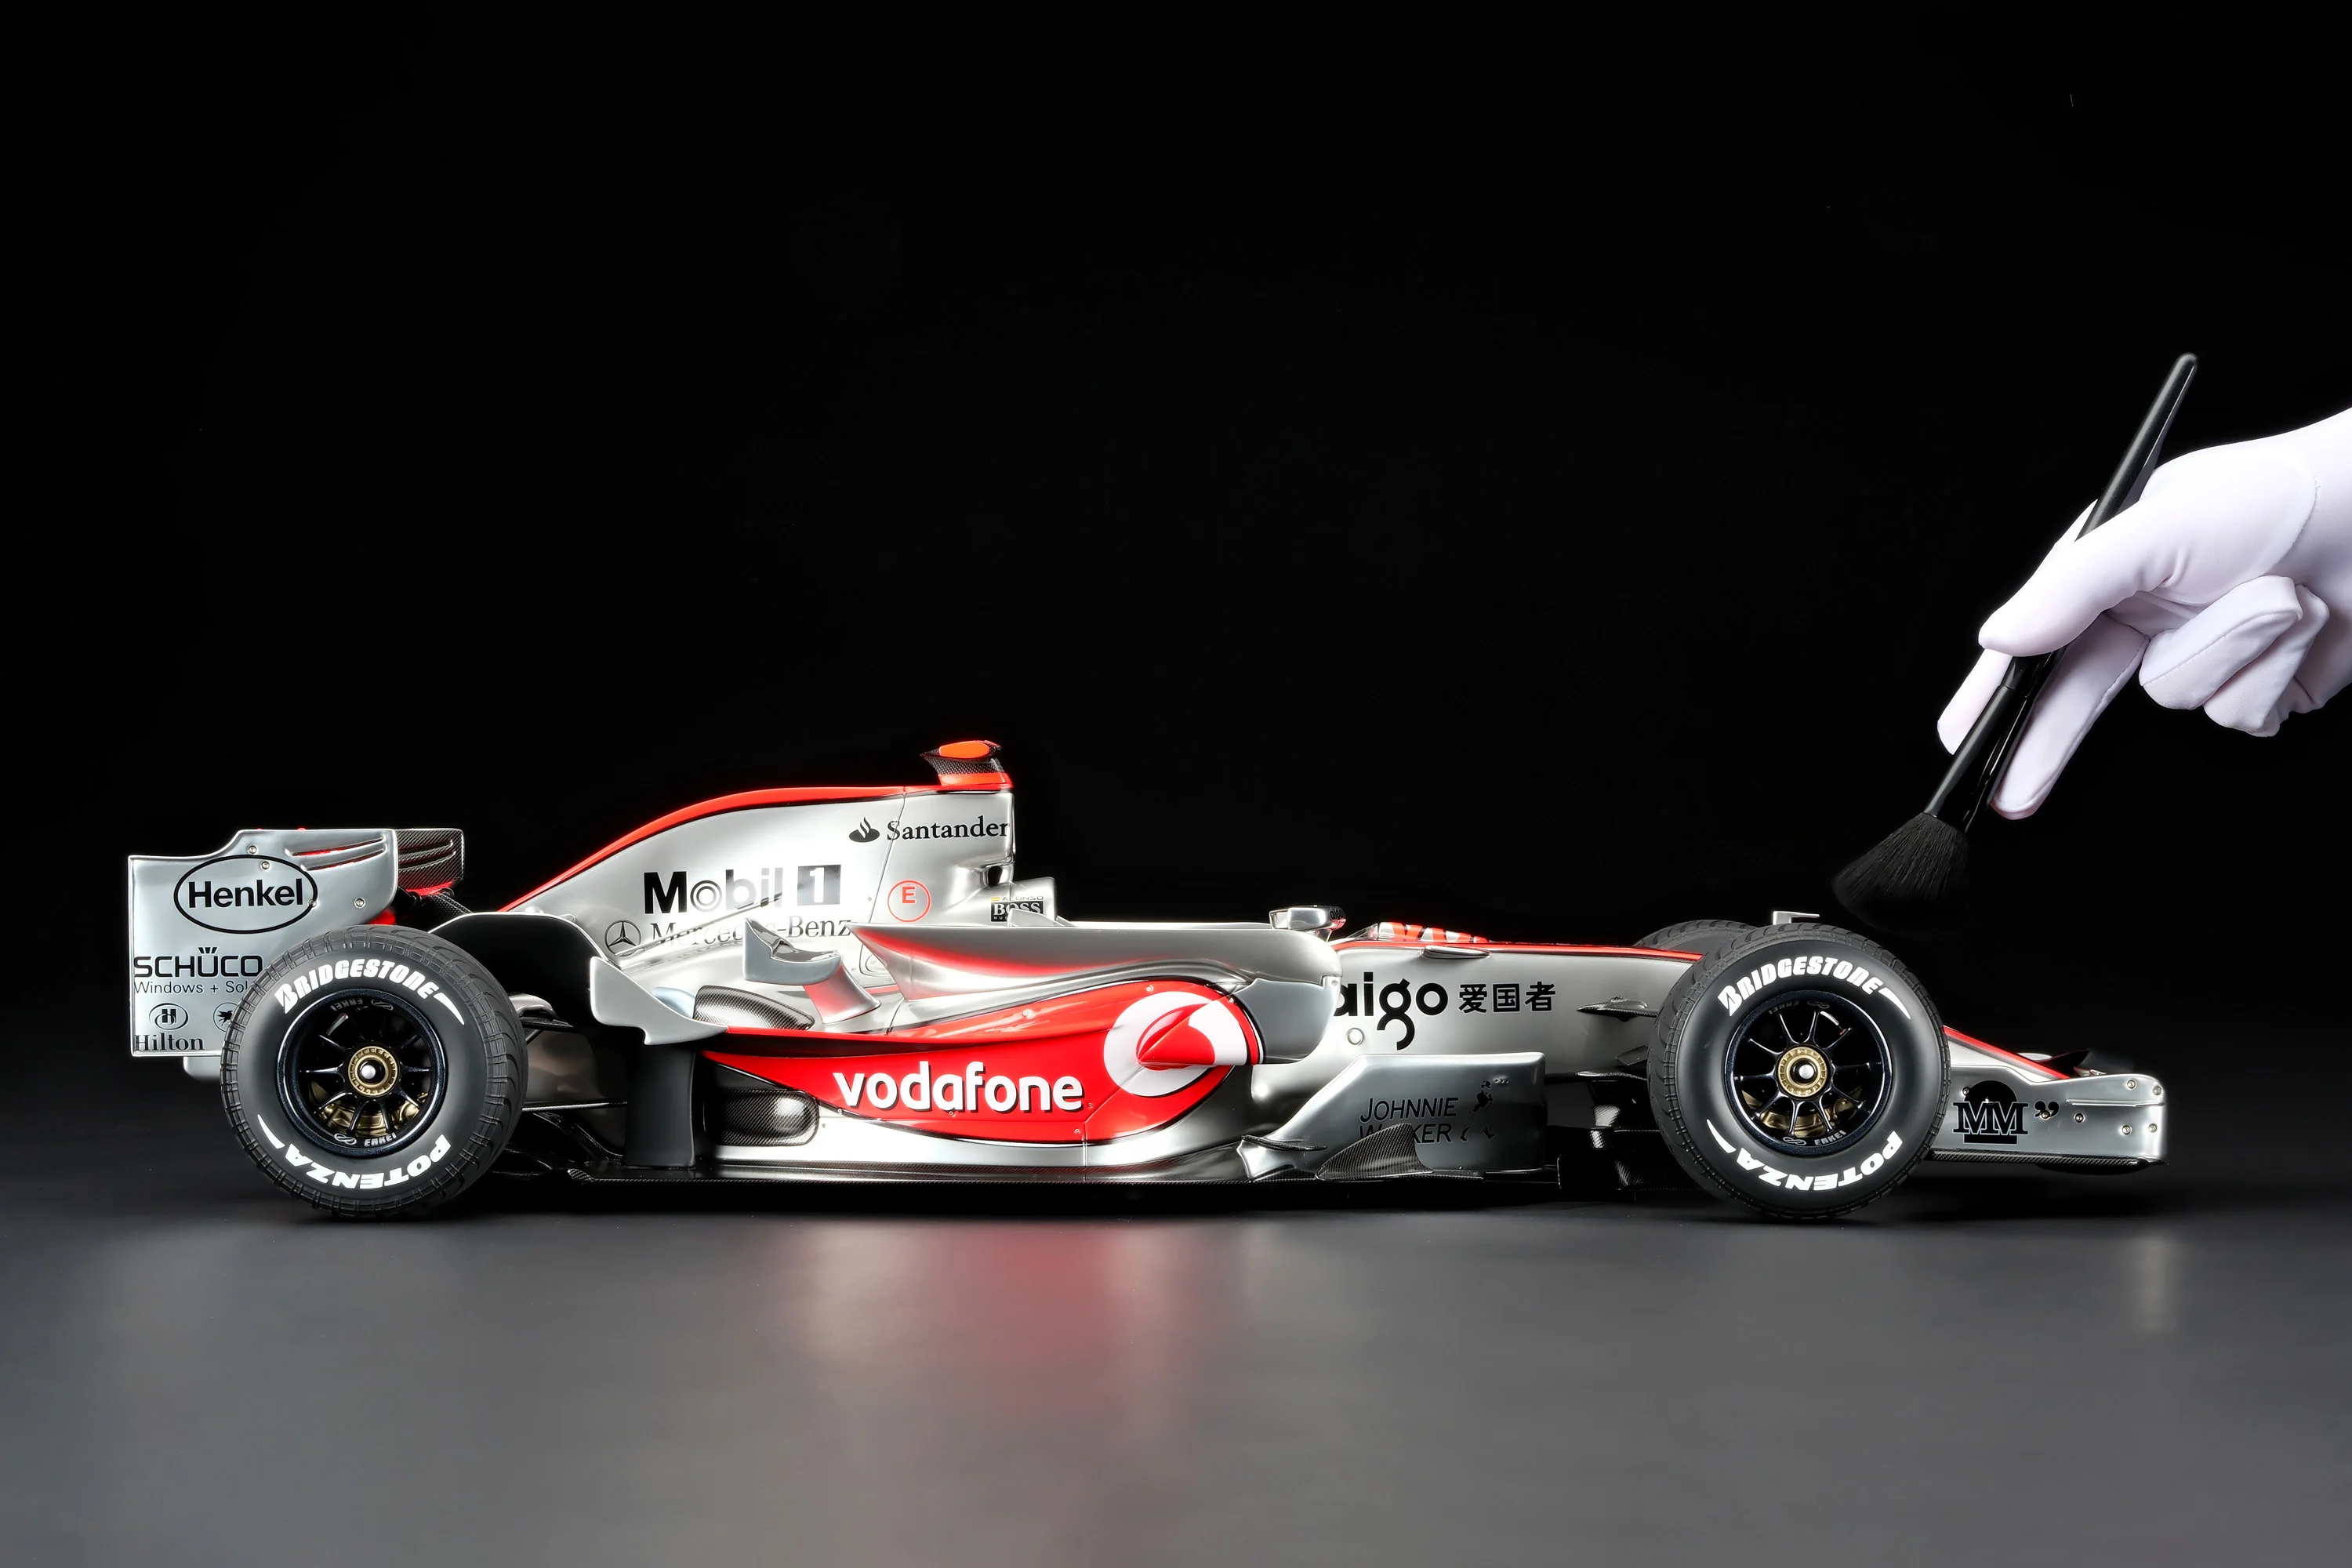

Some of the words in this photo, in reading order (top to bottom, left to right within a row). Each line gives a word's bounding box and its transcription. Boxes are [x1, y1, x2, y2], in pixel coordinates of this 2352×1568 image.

[887, 815, 1009, 840] Santander
[187, 878, 303, 909] Henkel
[644, 867, 783, 914] Mobil
[902, 886, 916, 904] E
[134, 947, 263, 978] SCHÜCO
[134, 982, 204, 993] Windows
[274, 958, 439, 1014] BRIDGESTONE
[1717, 956, 1883, 1017] BRIDGESTONE
[1334, 971, 1449, 1051] aigo
[1459, 981, 1556, 1014] 爱国者
[134, 1033, 205, 1051] Hilton
[833, 1061, 1085, 1113] vodafone
[1359, 1098, 1459, 1122] JOHNNIE
[364, 1132, 397, 1147] ENKEI
[1359, 1123, 1452, 1144] WKER
[1814, 1130, 1846, 1145] ENKEI
[285, 1134, 452, 1189] POTENZA
[1736, 1131, 1904, 1191] POTENZA
